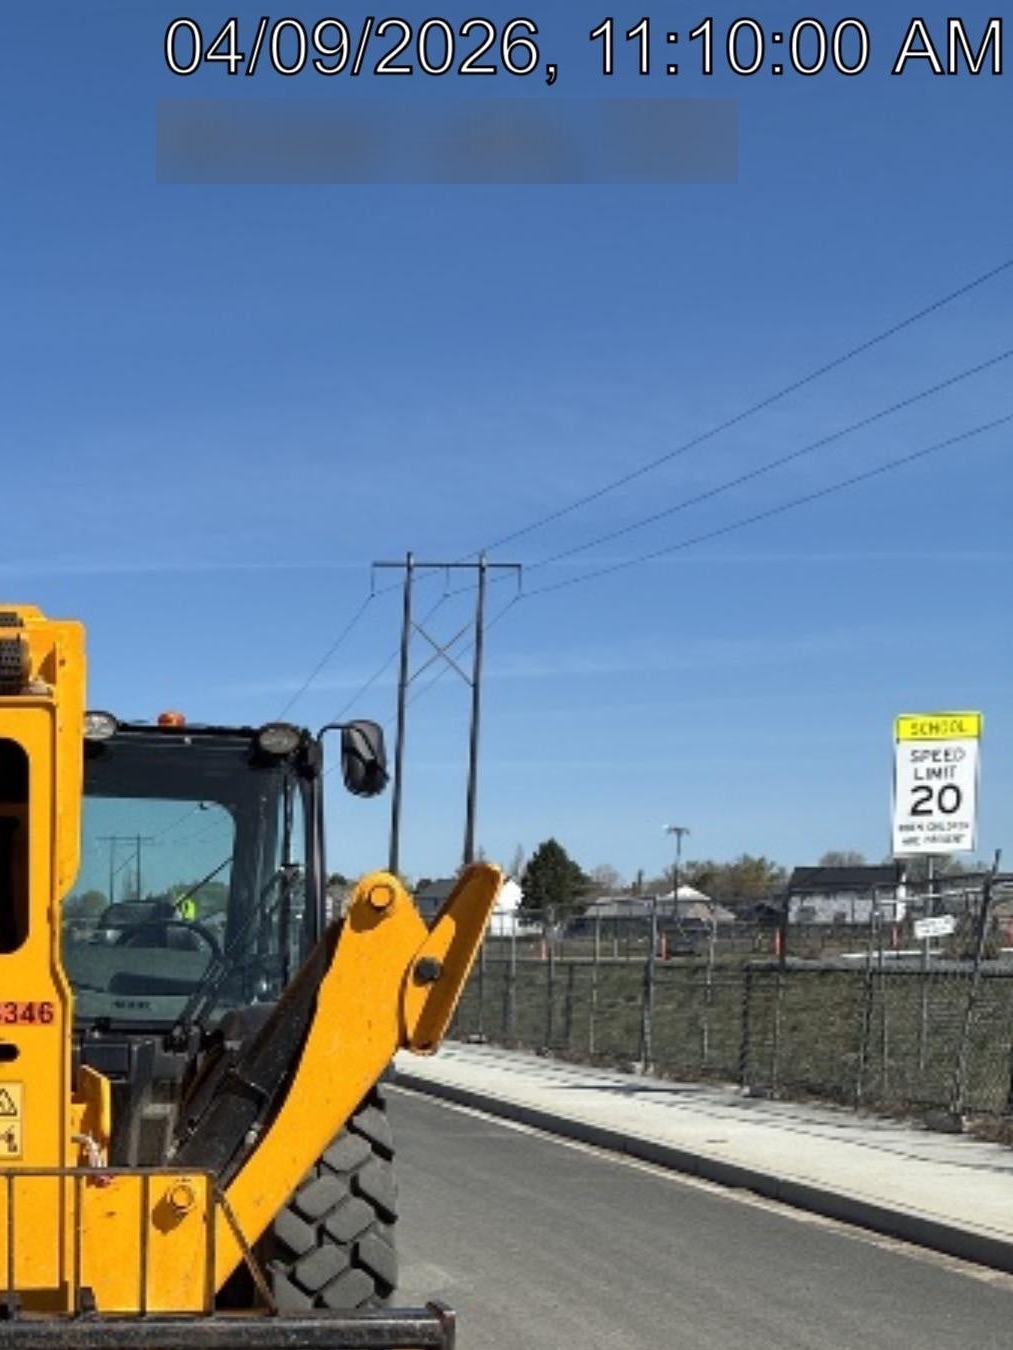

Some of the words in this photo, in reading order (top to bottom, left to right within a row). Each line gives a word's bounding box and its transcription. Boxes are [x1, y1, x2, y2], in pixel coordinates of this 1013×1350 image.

[910, 720, 967, 736] SCHOOL
[910, 747, 966, 762] SPEED
[914, 765, 957, 780] LIMIT
[910, 783, 962, 816] 20
